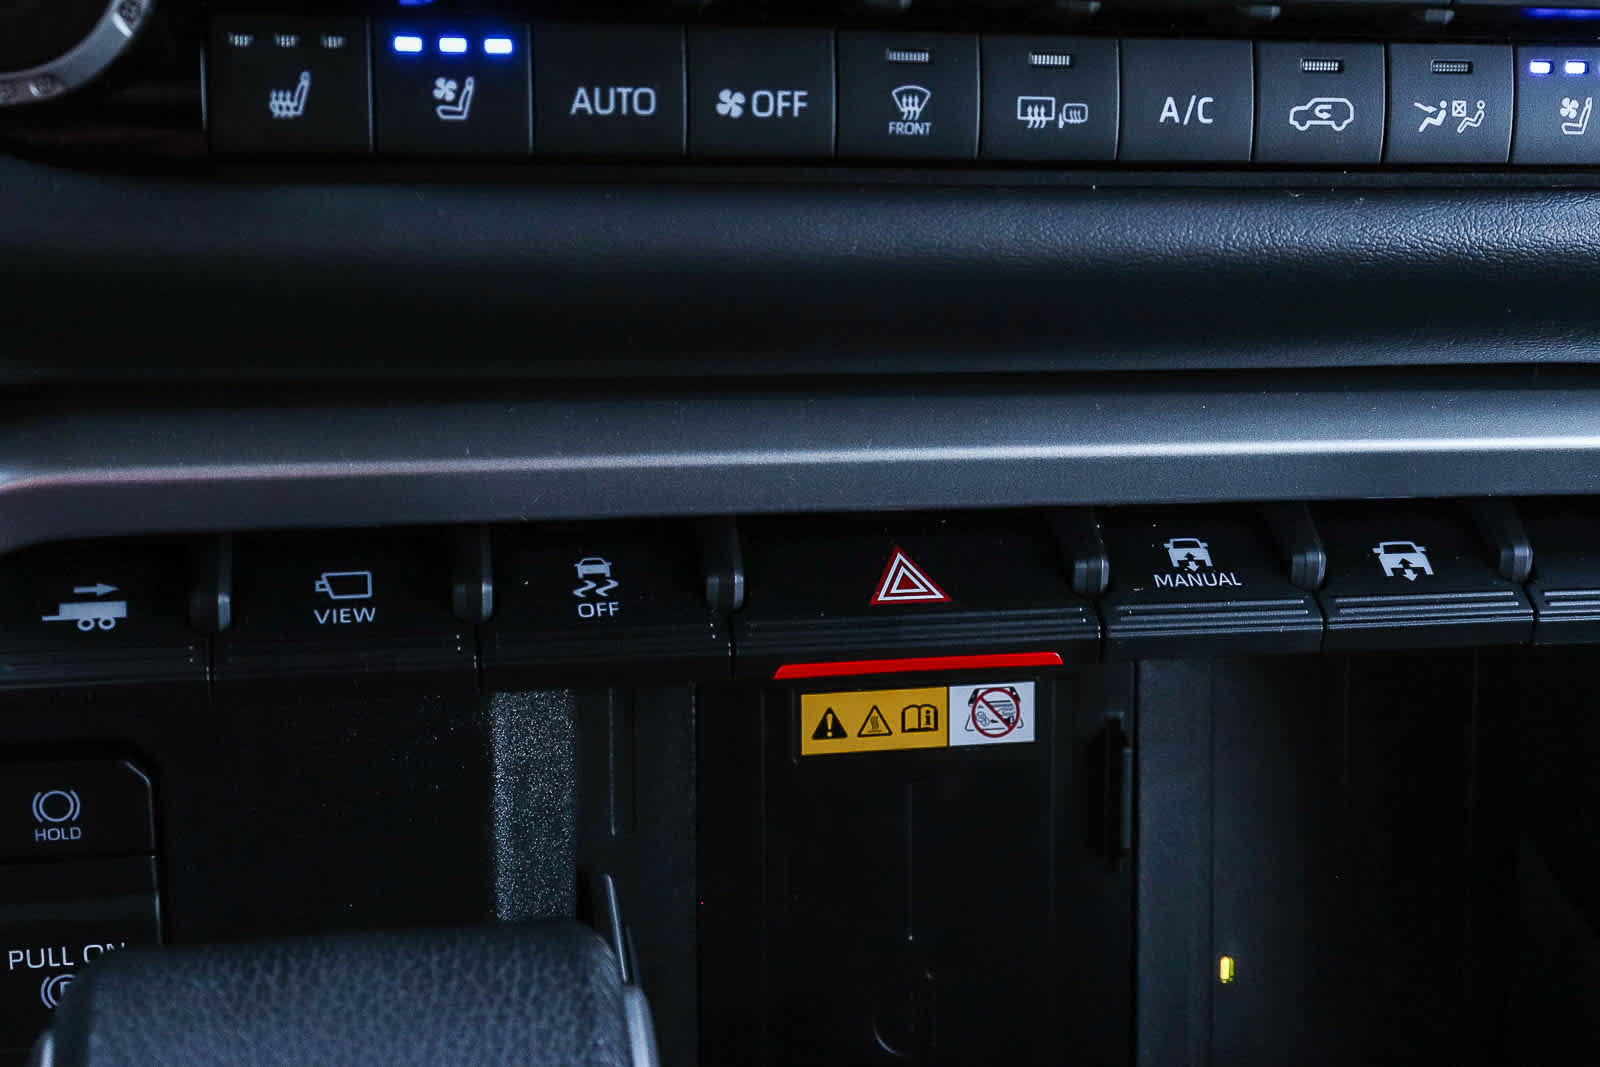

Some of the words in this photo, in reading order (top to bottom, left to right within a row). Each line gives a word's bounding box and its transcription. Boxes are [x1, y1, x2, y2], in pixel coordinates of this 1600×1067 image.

[570, 87, 656, 116] AUTO
[752, 90, 808, 118] OFF
[1159, 95, 1214, 126] A/C
[888, 121, 932, 135] FRONT
[1153, 571, 1242, 588] MANUAL
[313, 608, 376, 625] VIEW
[577, 601, 619, 618] OFF
[34, 827, 82, 841] HOLD
[8, 946, 75, 970] PULL
[82, 942, 126, 963] O
